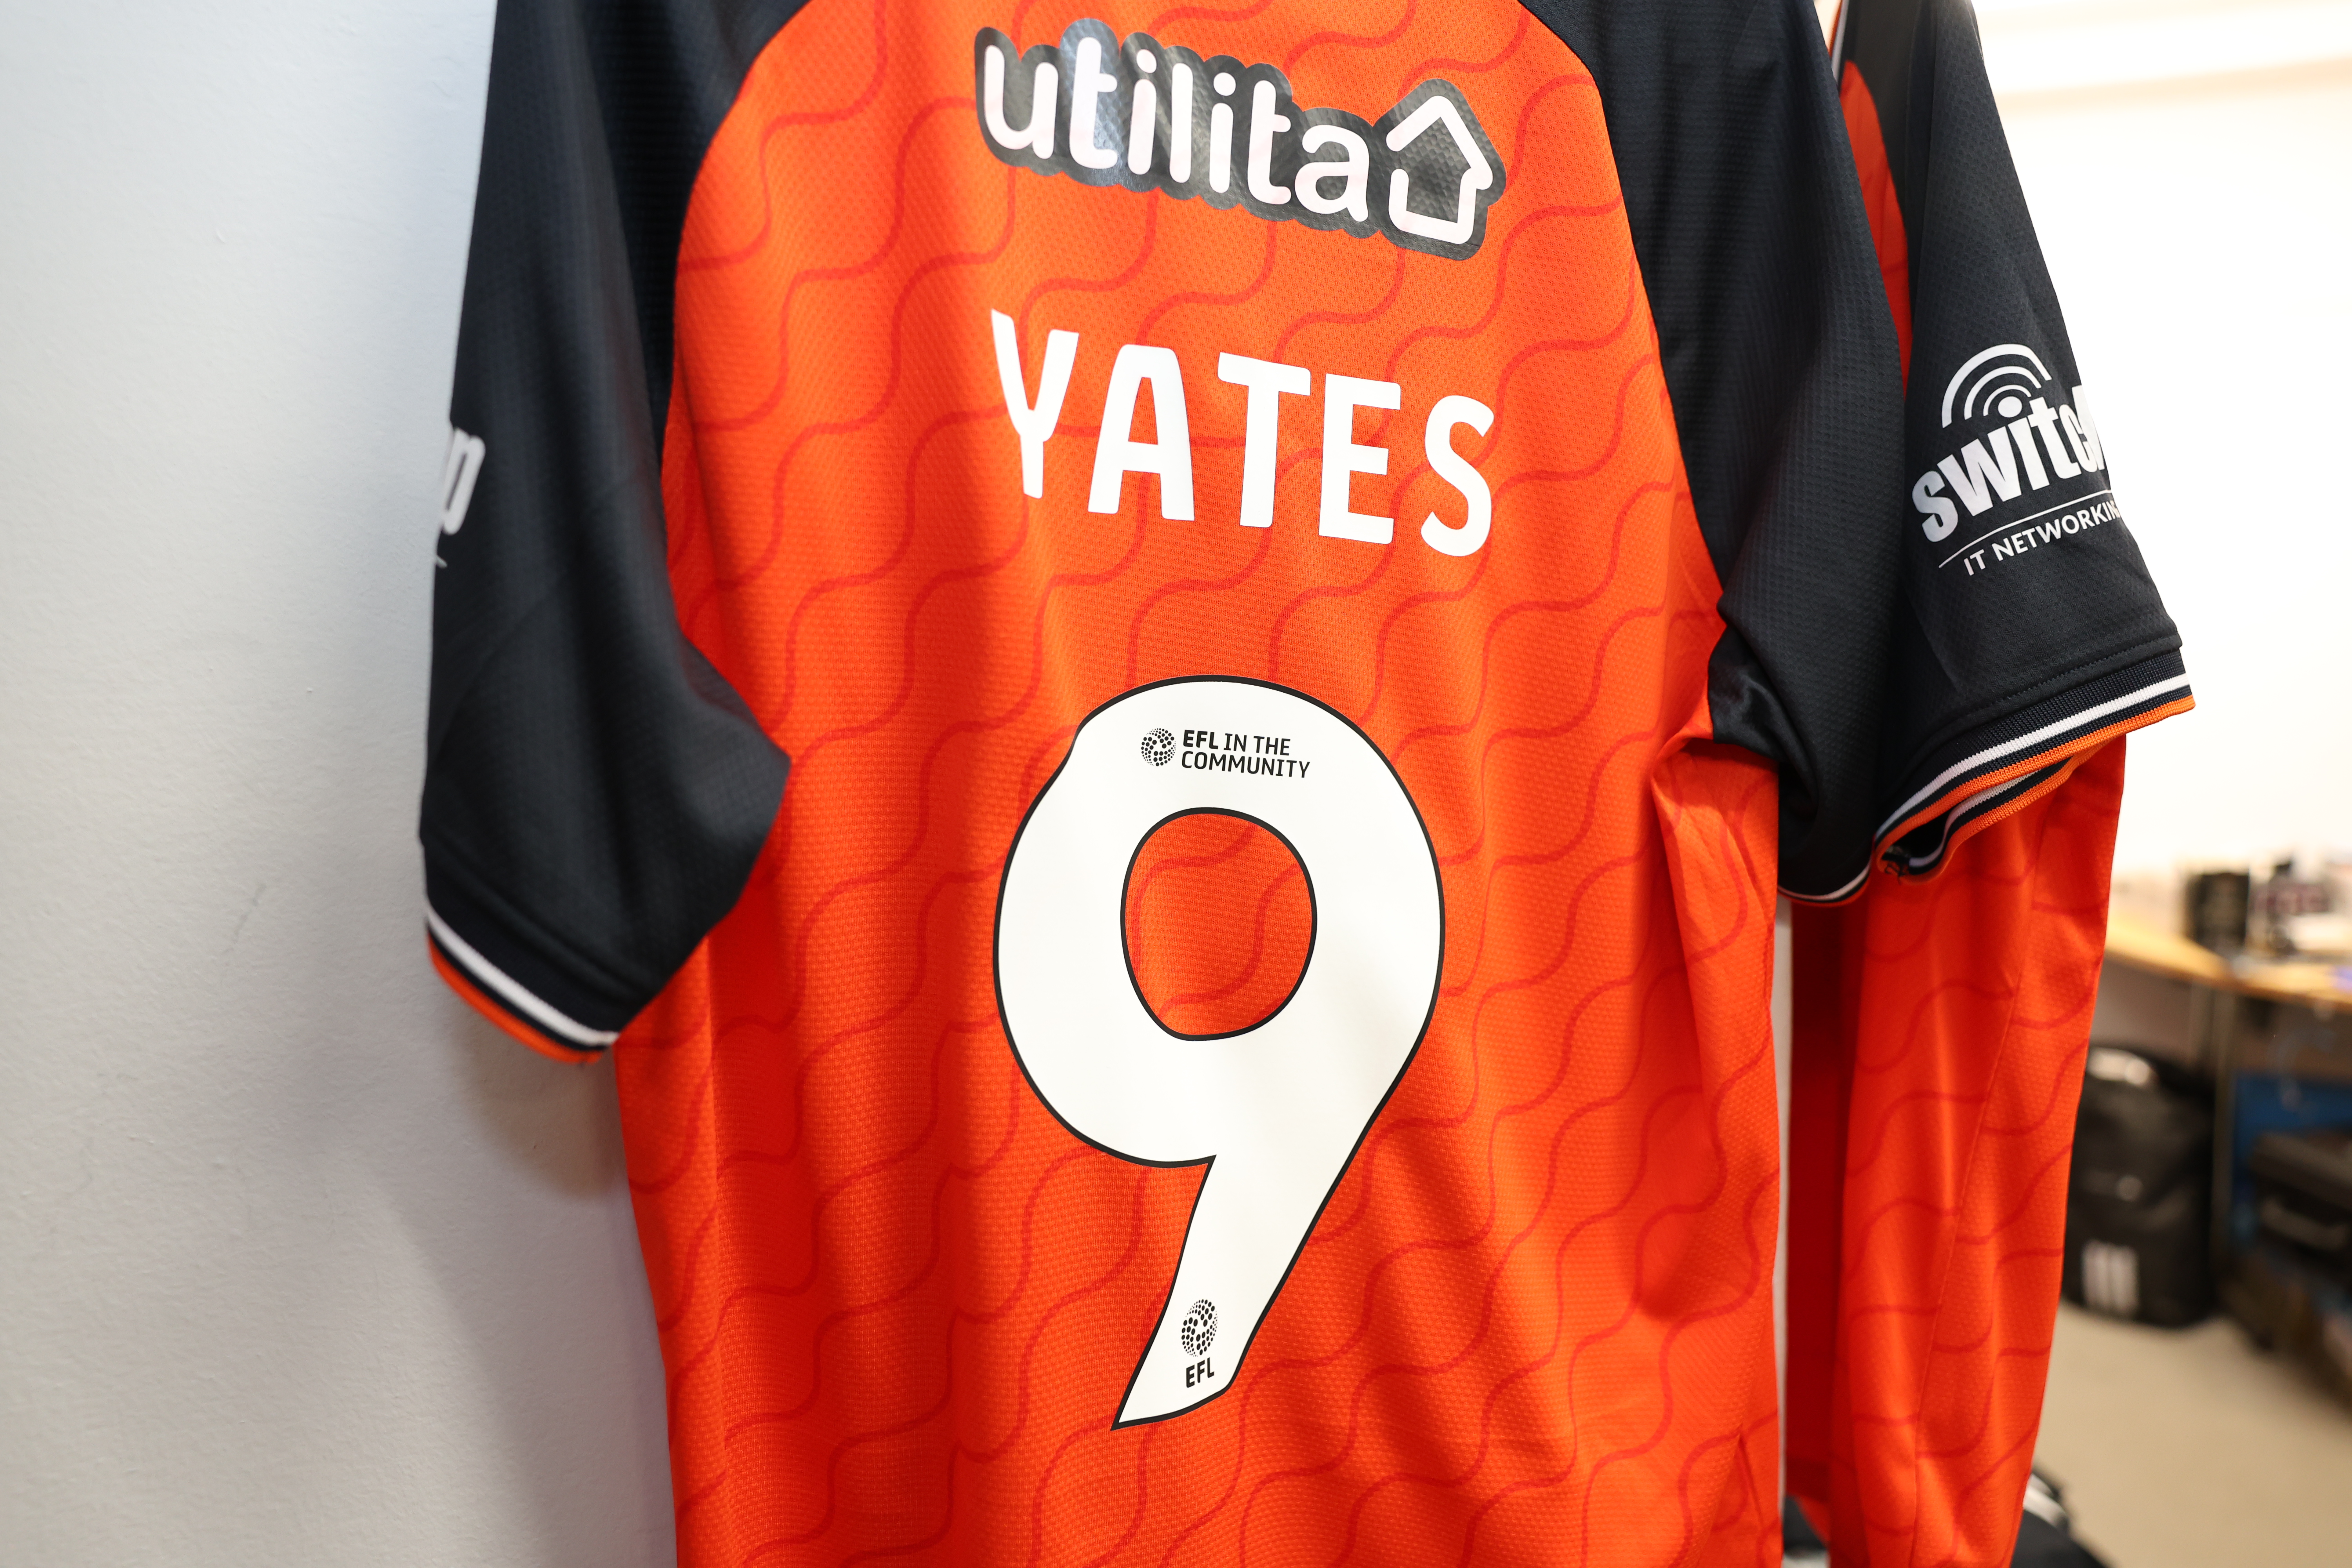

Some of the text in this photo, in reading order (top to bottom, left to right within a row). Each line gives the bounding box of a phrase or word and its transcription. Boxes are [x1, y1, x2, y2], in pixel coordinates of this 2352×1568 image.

[984, 36, 1370, 222] utilita
[991, 308, 1494, 557] YATES
[1963, 549, 1986, 576] IT
[1183, 730, 1290, 756] EFL IN THE
[1181, 751, 1310, 778] COMMUNITY
[995, 676, 1445, 1428] 9
[1186, 1357, 1214, 1388] EFL
